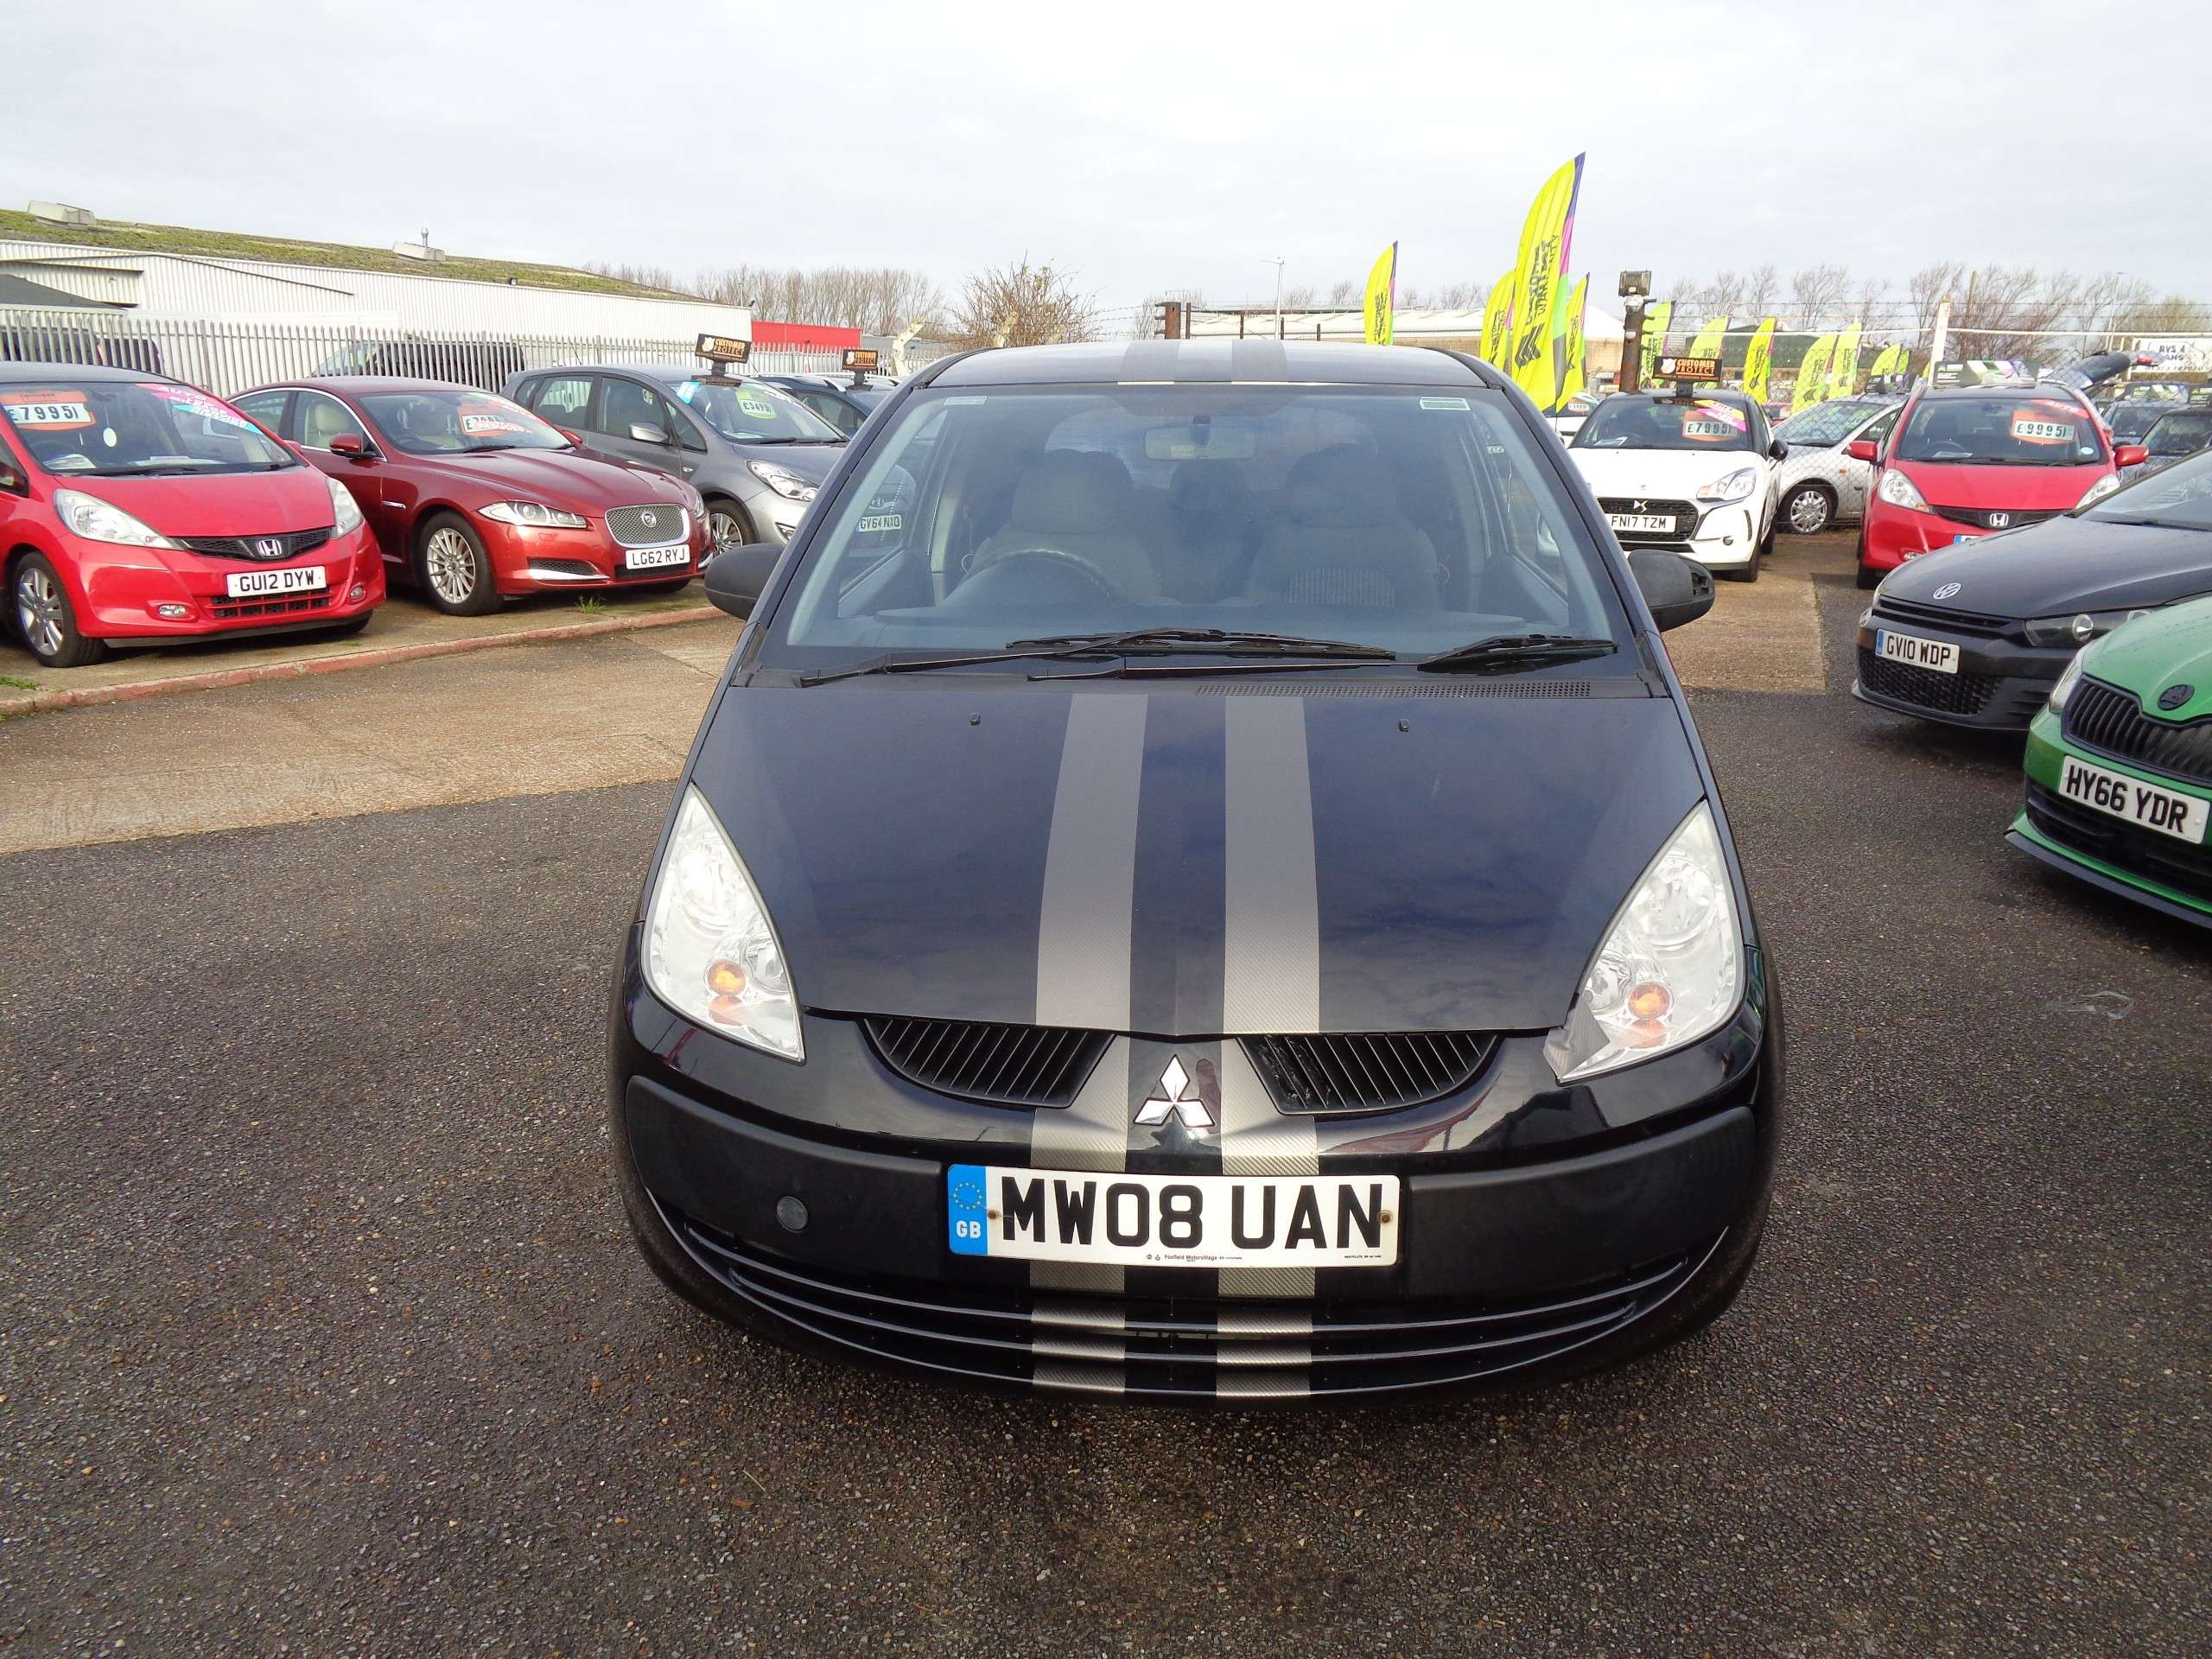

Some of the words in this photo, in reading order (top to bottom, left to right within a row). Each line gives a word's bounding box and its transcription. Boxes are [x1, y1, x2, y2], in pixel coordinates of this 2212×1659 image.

[713, 346, 745, 356] PROTECT
[715, 338, 746, 348] CUSTOMER
[1677, 359, 1716, 368] CUSTOMER
[1611, 515, 1639, 528] FN17
[1643, 517, 1667, 529] TZM
[632, 550, 663, 566] LG62
[664, 548, 685, 563] RYJ
[239, 573, 279, 592] GU12
[283, 569, 315, 588] DYW
[1886, 634, 1916, 660] GV10
[1920, 642, 1951, 667] WDP
[2066, 765, 2128, 812] HY66
[2135, 787, 2189, 833] YDR
[1001, 1176, 1204, 1249] MW08
[1231, 1183, 1382, 1249] UAN
[955, 1219, 982, 1239] GB
